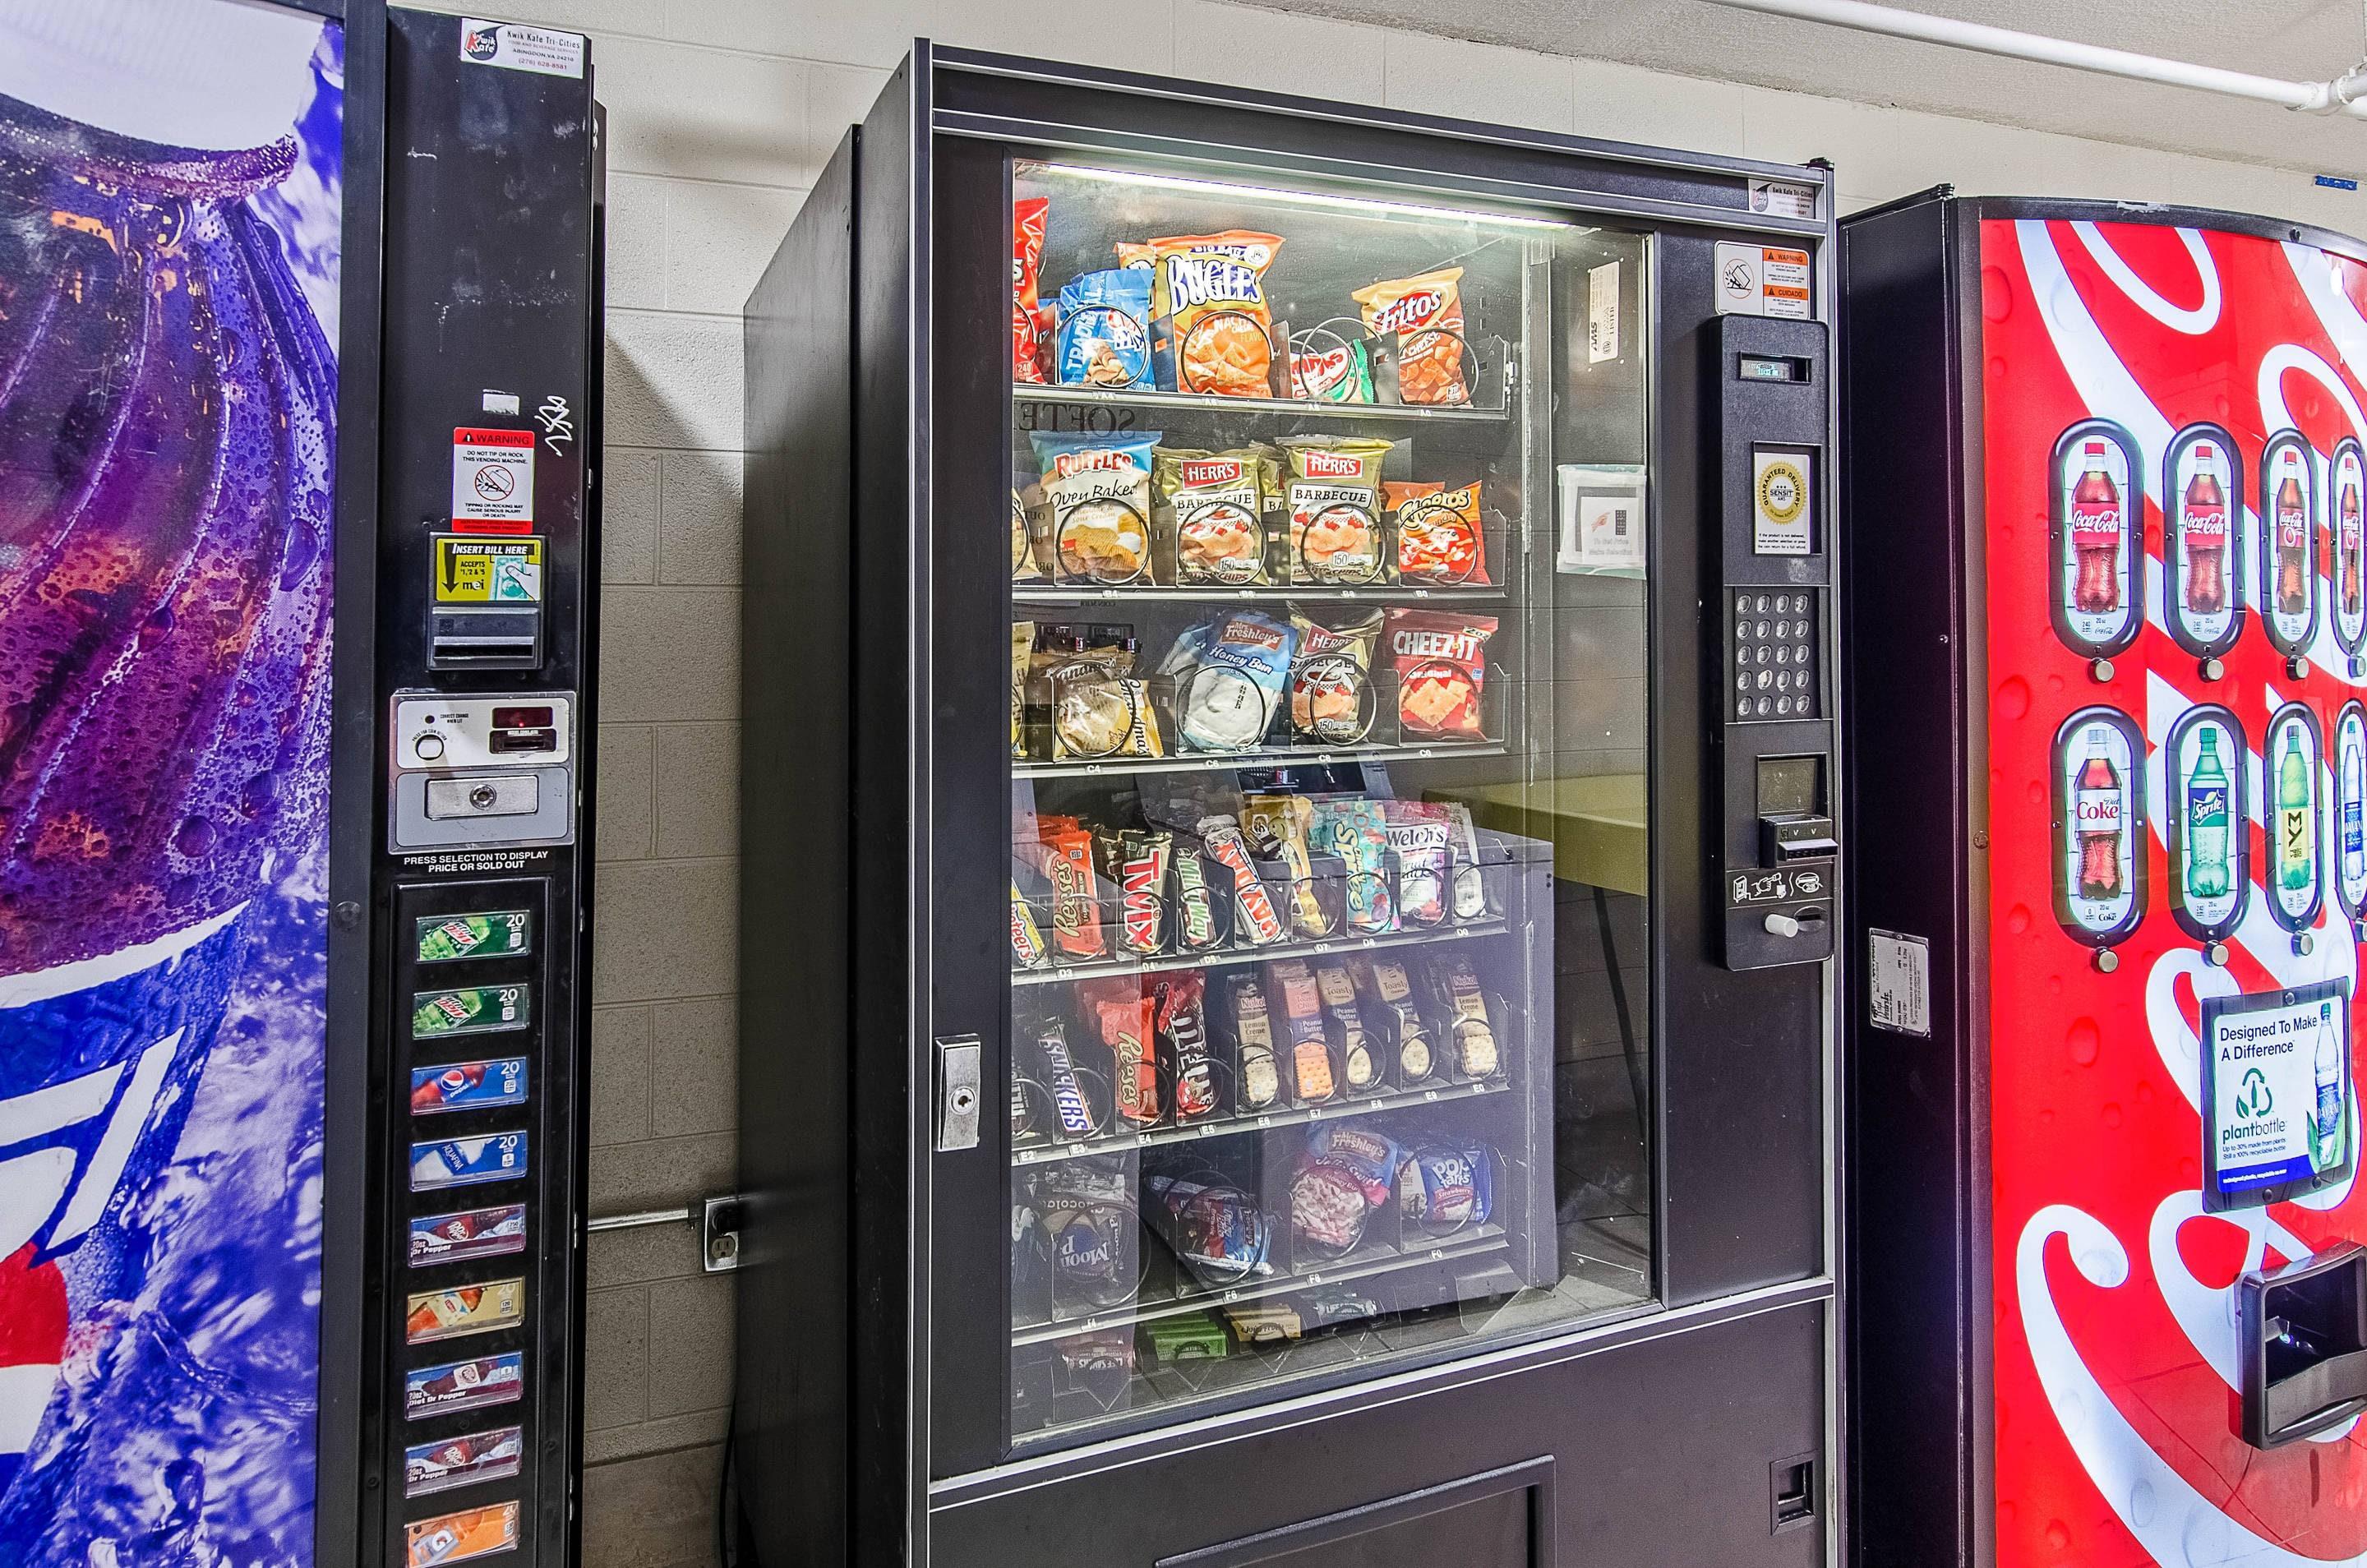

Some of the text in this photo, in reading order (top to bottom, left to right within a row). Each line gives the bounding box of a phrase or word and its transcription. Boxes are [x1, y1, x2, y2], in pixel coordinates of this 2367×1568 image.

[507, 30, 580, 48] Kwik Kafe Tri-Cities
[1777, 253, 1803, 262] WARNING
[1167, 254, 1262, 315] BUGLES
[1778, 288, 1802, 297] CUIDADO
[1371, 289, 1442, 334] Fritos
[1214, 313, 1256, 330] NACHO
[1590, 321, 1599, 352] AMS
[477, 434, 529, 445] WARNING
[1053, 450, 1134, 480] RUFFLES
[1309, 453, 1357, 475] HERR'S
[1188, 463, 1236, 482] HERR'S
[1050, 478, 1141, 508] Oven Baked
[1762, 468, 1801, 508] GUARANTEED DELIVERY
[1295, 489, 1368, 503] BARBECUE
[2073, 509, 2120, 534] Coca-Cola
[2185, 510, 2224, 535] Coca-Cola
[451, 542, 528, 555] INSERT BILL HERE
[1220, 560, 1234, 570] 150
[1333, 554, 1348, 565] 150
[462, 579, 484, 590] mei
[1225, 625, 1280, 646] Freshley's
[1208, 646, 1273, 675] Honey Bun
[1318, 720, 1332, 731] 150
[1206, 759, 1220, 768] C6
[1318, 754, 1331, 763] C8
[1087, 764, 1101, 773] C4
[2075, 800, 2120, 821] Coke
[2193, 796, 2225, 821] Sprite
[1386, 827, 1445, 846] Welch's
[404, 851, 548, 865] PRESS SELECTION TO DISPLAY
[428, 860, 525, 873] PRICE OR SOLD OUT
[1333, 820, 1364, 912] Spree
[1123, 847, 1160, 948] TWIX
[506, 914, 525, 927] 20
[2098, 912, 2117, 921] Coke
[1316, 943, 1329, 952] D7
[1203, 955, 1217, 964] D5
[1059, 968, 1073, 977] D3
[1142, 962, 1156, 971] D4
[1325, 986, 1353, 996] Toasty
[1383, 979, 1408, 991] Toasty
[499, 989, 518, 1002] 20
[1458, 996, 1479, 1006] Lemon
[1336, 1007, 1356, 1015] Peanut
[1460, 1003, 1479, 1011] Creme
[1243, 1021, 1267, 1030] Lemon
[1302, 1018, 1322, 1027] Peanut
[1244, 1027, 1267, 1035] Creme
[1303, 1026, 1322, 1034] Butter
[2220, 1016, 2318, 1042] Designed To Make
[2222, 1040, 2294, 1062] A Difference
[501, 1061, 519, 1075] 20
[1037, 1039, 1089, 1132] SNICKERS
[1425, 1091, 1438, 1100] E9
[1371, 1100, 1384, 1109] E8
[1310, 1109, 1322, 1118] E7
[1257, 1117, 1271, 1126] E6
[1202, 1126, 1215, 1135] E5
[2222, 1117, 2286, 1145] plantbottle
[498, 1135, 518, 1149] 20
[1138, 1135, 1151, 1144] E4
[1331, 1132, 1386, 1158] Freshley's
[1021, 1151, 1036, 1160] E2
[1071, 1145, 1085, 1154] E3
[441, 1144, 464, 1171] AQUAFINA
[1349, 1164, 1383, 1188] Swirl
[422, 1244, 451, 1254] Pepper
[1059, 1242, 1110, 1268] Moon
[1309, 1275, 1322, 1284] F8
[1225, 1290, 1238, 1300] F6
[429, 1395, 437, 1404] Dr
[437, 1390, 467, 1402] Pepper
[419, 1469, 449, 1481] Pepper
